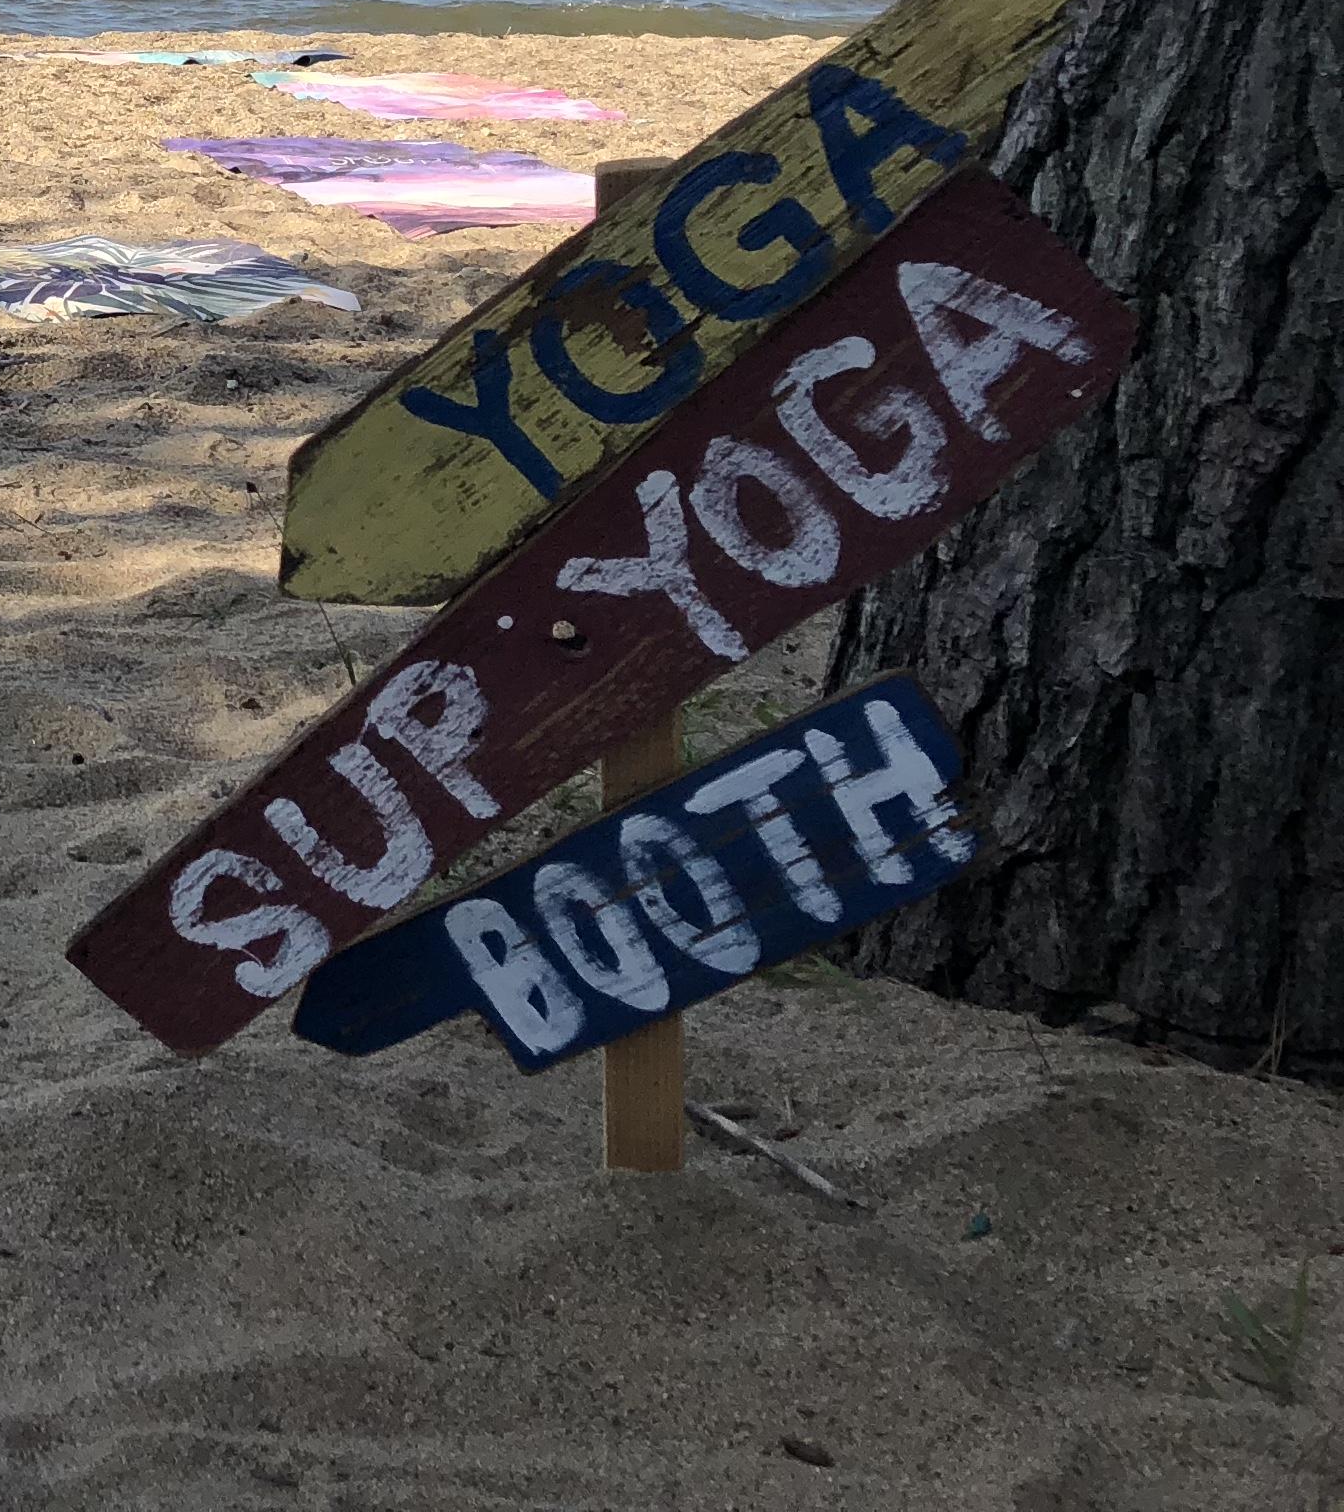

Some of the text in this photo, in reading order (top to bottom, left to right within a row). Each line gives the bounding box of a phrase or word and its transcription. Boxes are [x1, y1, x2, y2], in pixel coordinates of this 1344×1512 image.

[400, 61, 966, 500] YOGA
[168, 261, 1092, 998] SUP YOGA
[444, 699, 976, 1055] BOOTH
